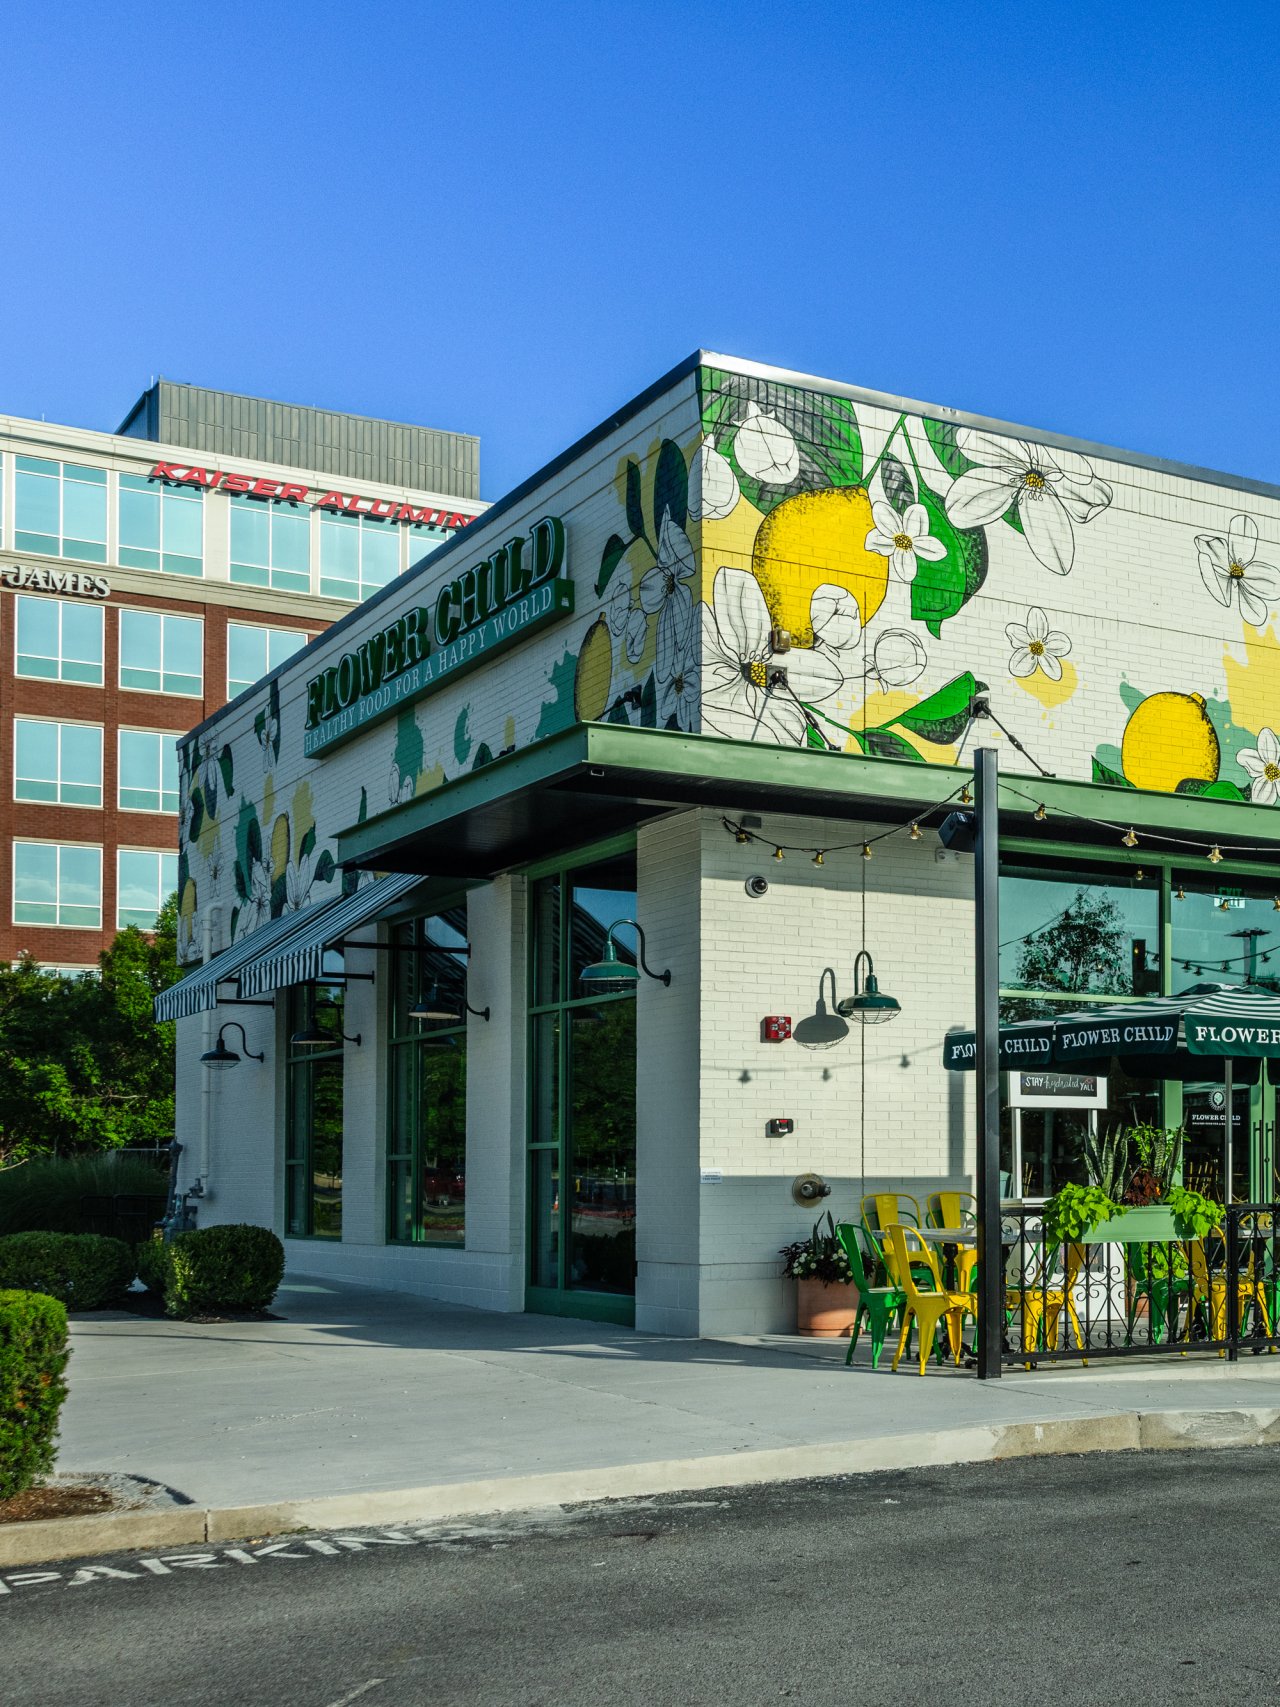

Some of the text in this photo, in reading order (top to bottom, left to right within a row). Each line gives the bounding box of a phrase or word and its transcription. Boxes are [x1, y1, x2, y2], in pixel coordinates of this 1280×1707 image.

[152, 460, 308, 503] KAISER
[5, 564, 111, 598] JAMES
[304, 515, 565, 730] FLOWER CHILD
[304, 586, 553, 754] HEALTHY FOOD FOR A HAPPY WORLD
[1004, 1037, 1050, 1054] CHILD
[1062, 1026, 1174, 1049] FLOWER CHILD
[1025, 1076, 1043, 1087] STAY
